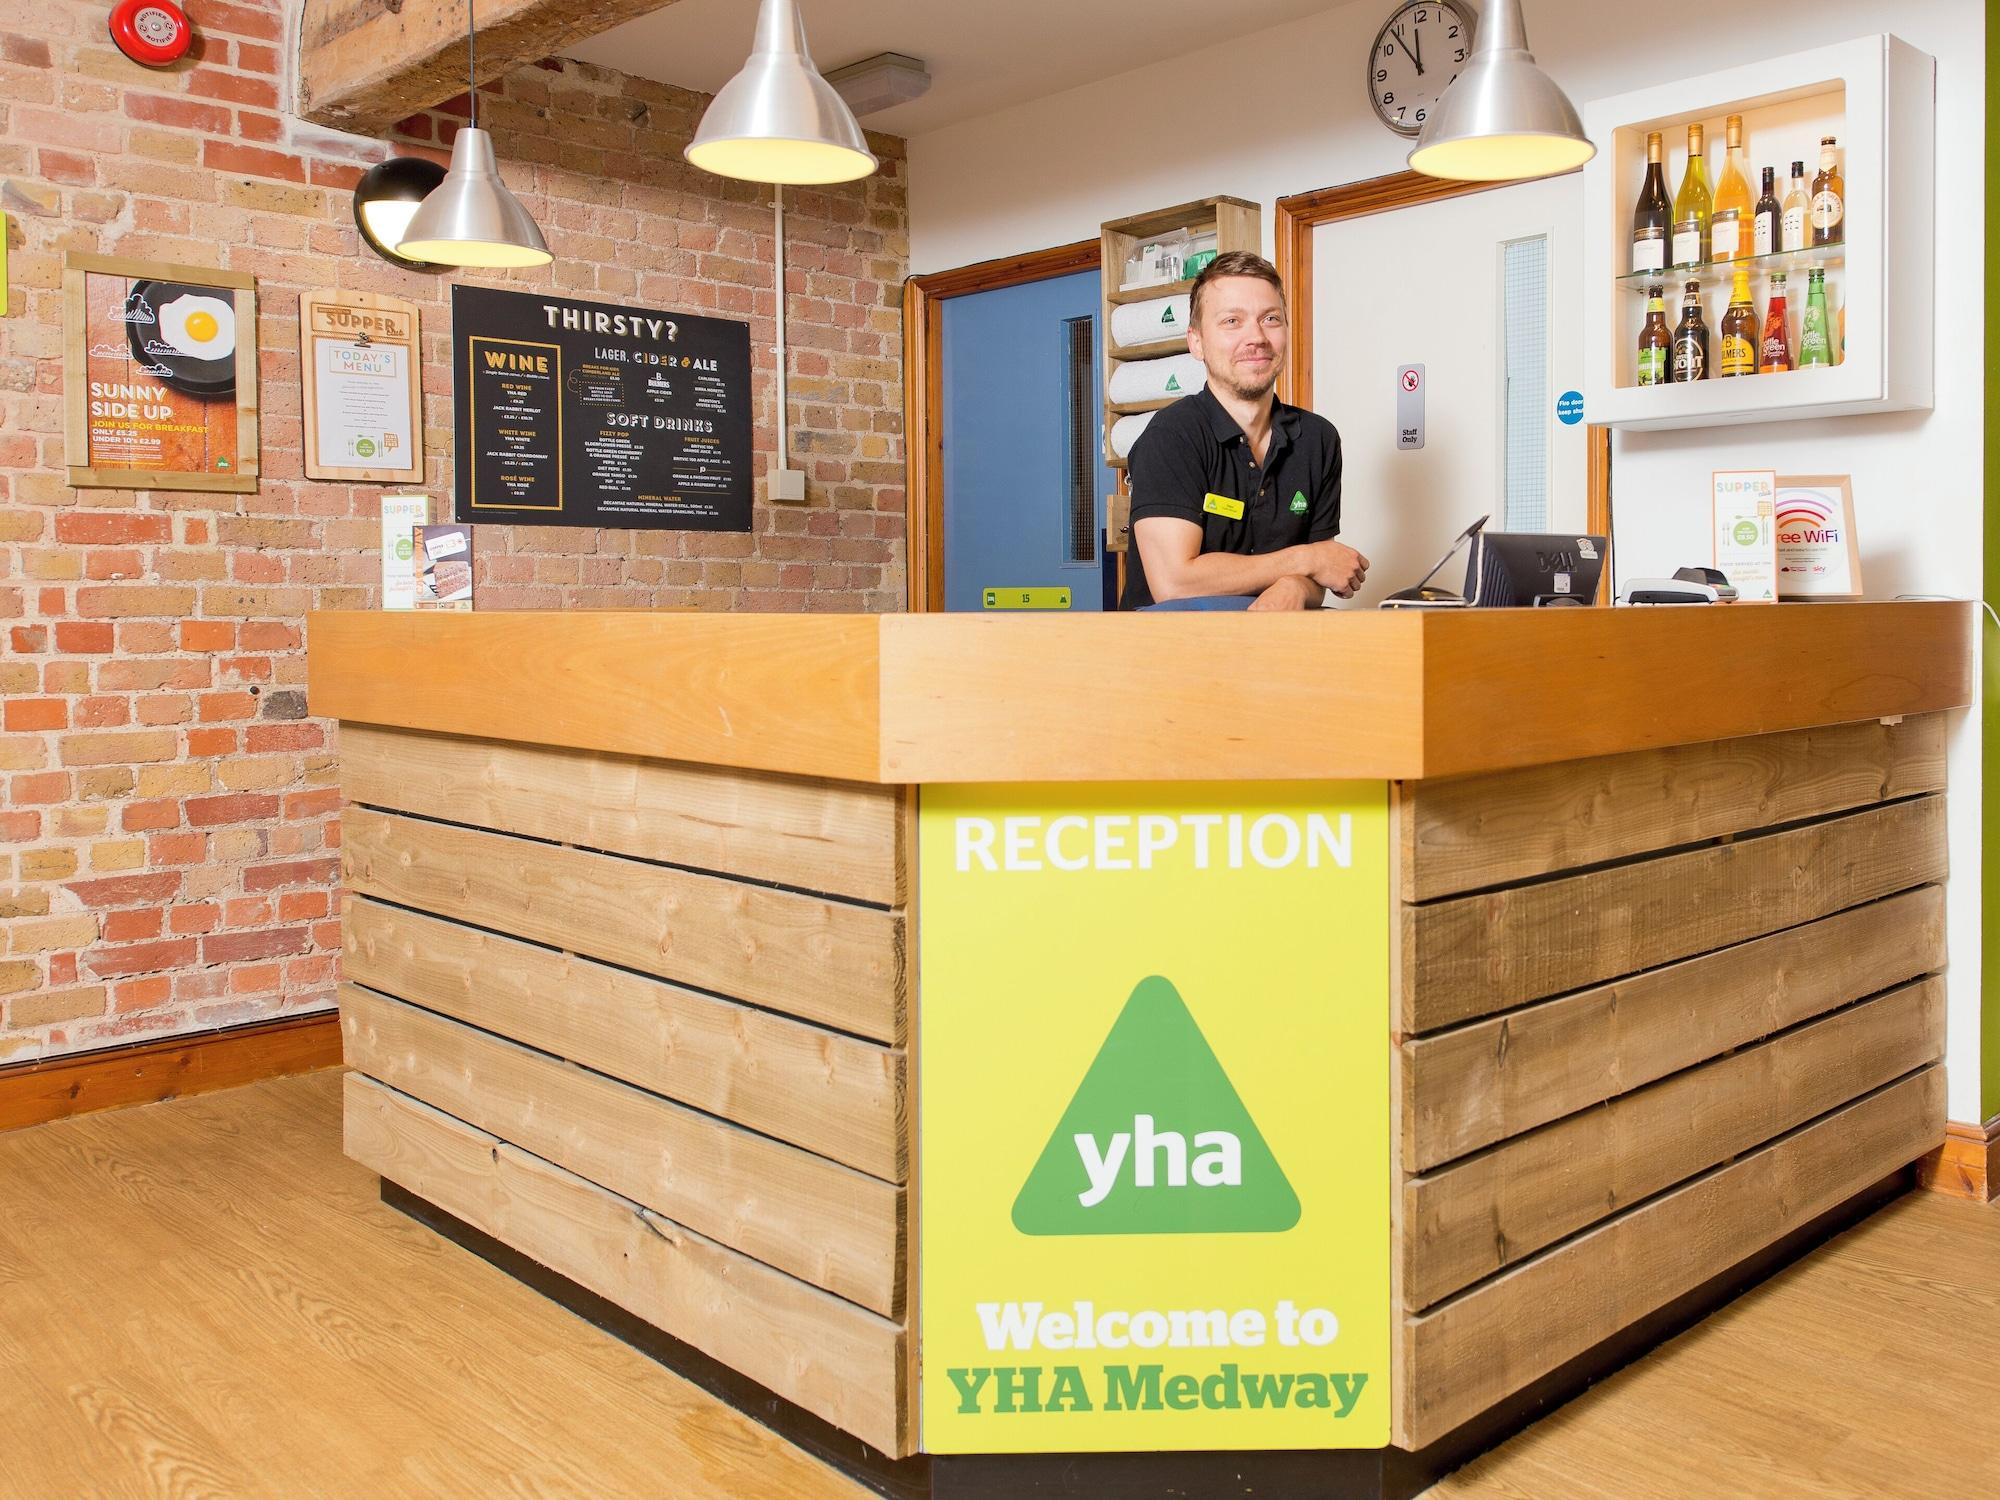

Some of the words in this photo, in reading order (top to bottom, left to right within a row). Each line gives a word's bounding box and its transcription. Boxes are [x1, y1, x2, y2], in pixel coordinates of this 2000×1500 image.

[140, 11, 167, 22] NOTIFIER
[1414, 10, 1427, 24] 12
[146, 33, 173, 43] NOTIFIER
[1448, 25, 1458, 39] 2
[1383, 44, 1394, 57] 10
[1454, 48, 1464, 62] 3
[1377, 69, 1387, 82] 9
[1383, 92, 1394, 104] 8
[1397, 106, 1406, 119] 7
[1416, 109, 1426, 122] 6
[326, 313, 396, 332] SUPPER
[543, 305, 679, 343] THIRSTY?
[334, 350, 391, 364] TODAY'S
[484, 351, 549, 373] WINE
[595, 347, 630, 362] LAGER,
[632, 351, 678, 368] CIDER
[681, 357, 690, 368] &
[692, 358, 718, 372] ALE
[344, 361, 382, 372] MENU
[90, 382, 168, 402] SUNNY
[91, 401, 140, 420] SIDE
[144, 404, 174, 420] UP
[92, 420, 115, 428] JOIN
[133, 422, 154, 430] FOR
[156, 424, 209, 433] BREAKFAST
[606, 412, 649, 428] SOFT
[654, 416, 713, 433] DRINKS
[1402, 428, 1417, 436] Staff
[1716, 482, 1768, 492] SUPPER
[384, 504, 422, 514] SUPPER
[1294, 501, 1307, 509] yha
[1776, 534, 1801, 543] ree
[1804, 530, 1838, 542] WiFi
[1536, 552, 1578, 572] DELL
[1022, 594, 1030, 603] 15
[956, 814, 1352, 872] RECEPTION
[1074, 1114, 1242, 1207] yha
[976, 1302, 1268, 1350] Welcome
[1276, 1301, 1339, 1346] to
[946, 1367, 1092, 1414] YHA
[1104, 1364, 1368, 1418] Medway
